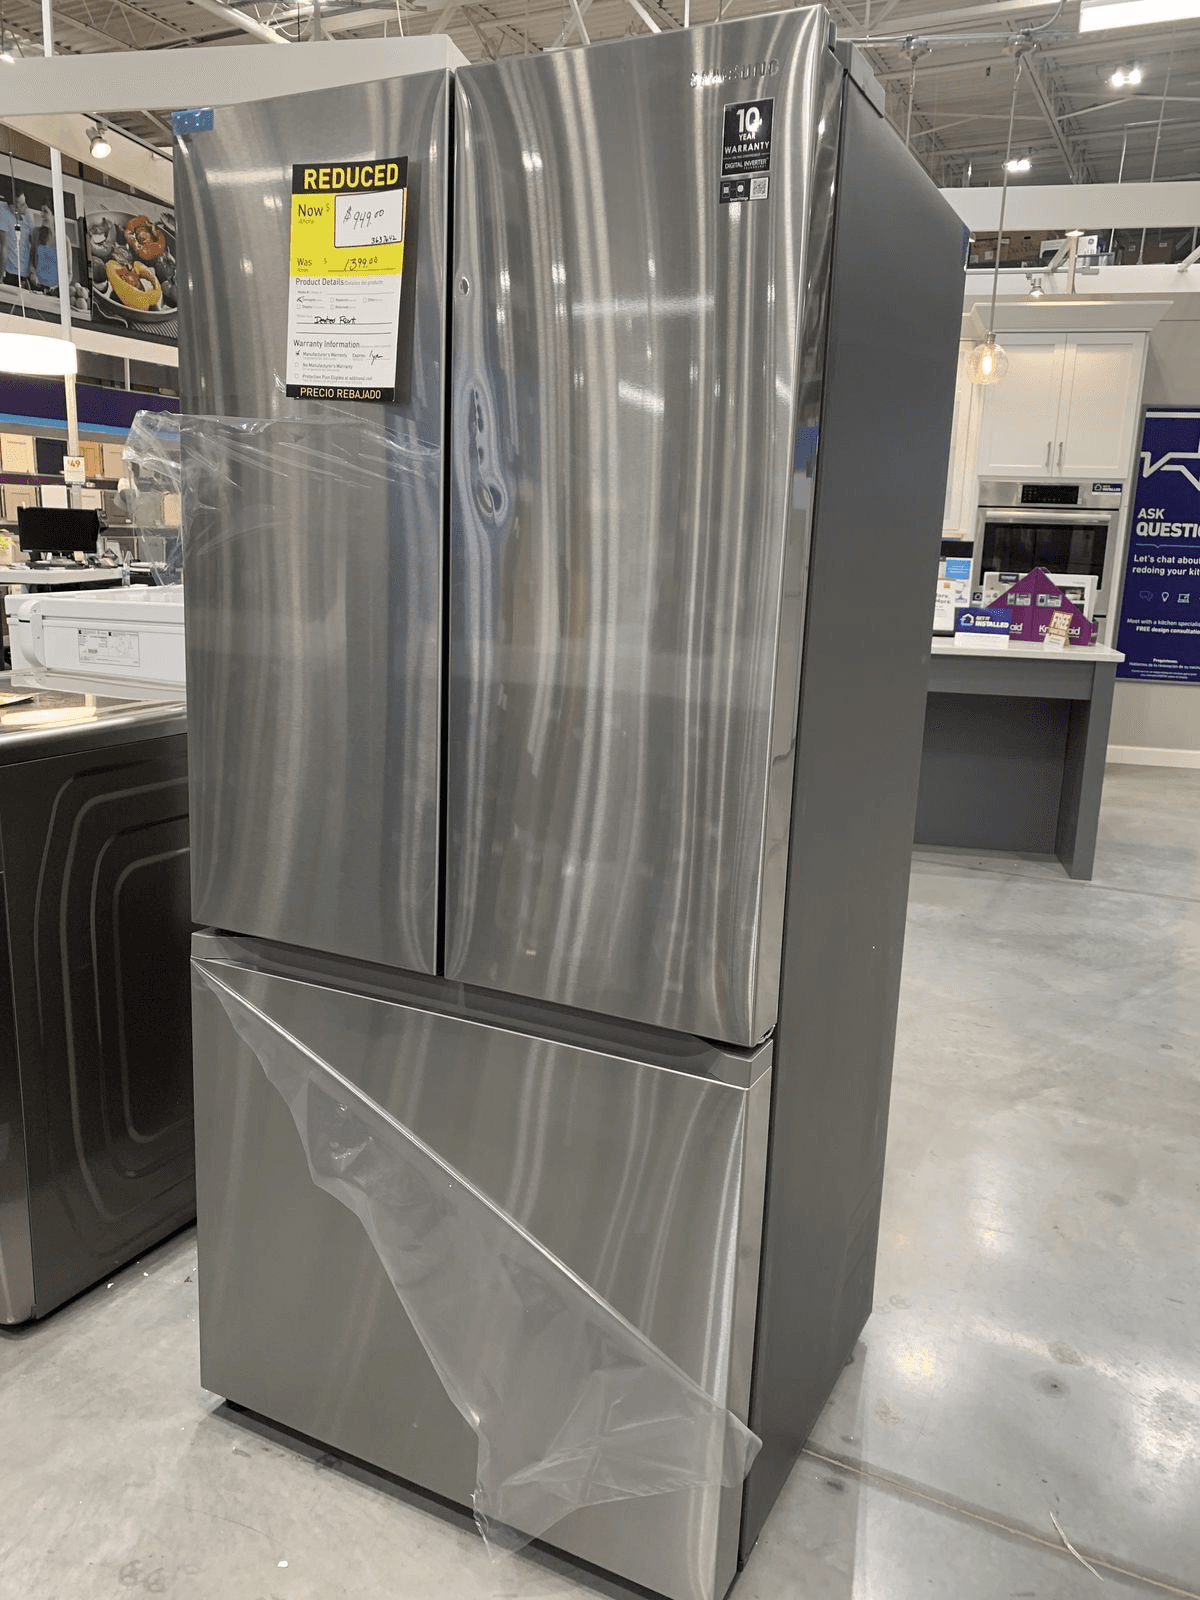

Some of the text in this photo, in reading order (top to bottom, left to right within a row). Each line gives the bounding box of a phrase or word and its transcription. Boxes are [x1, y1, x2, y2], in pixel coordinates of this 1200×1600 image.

[739, 132, 756, 141] YEAR
[724, 141, 770, 154] WARRANTY
[724, 158, 767, 170] DIGITAL INVERTER
[304, 163, 399, 190] REDUCED
[298, 204, 323, 217] Now
[296, 258, 312, 266] Was
[296, 278, 320, 286] Product
[322, 278, 344, 286] Details
[294, 340, 322, 348] Warranty
[300, 387, 382, 400] PRECIO REBAJADO
[1137, 508, 1165, 520] ASK
[1136, 522, 1200, 538] QUESTI
[1134, 554, 1154, 563] Let's
[1156, 555, 1175, 564] chat
[1132, 566, 1165, 576] redoing
[1167, 568, 1187, 576] your
[974, 620, 1010, 628] INSTALLED
[1151, 626, 1169, 634] design
